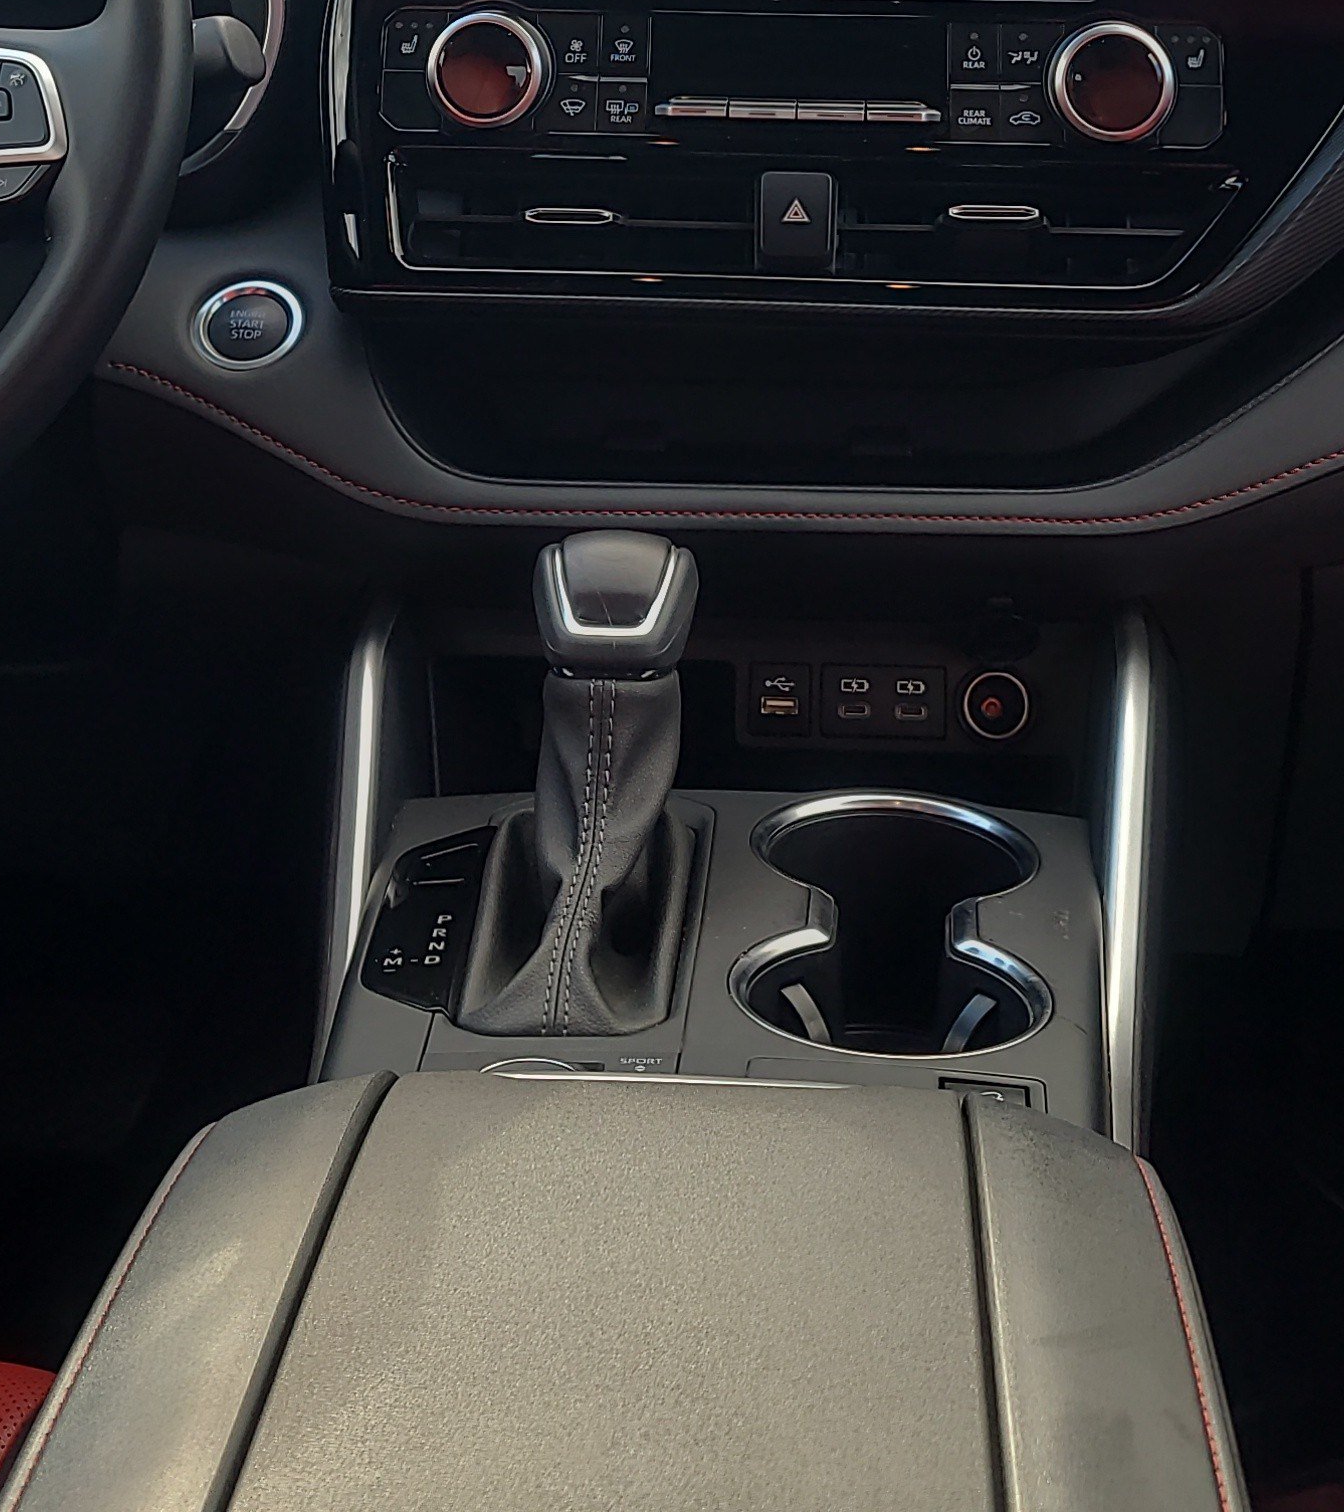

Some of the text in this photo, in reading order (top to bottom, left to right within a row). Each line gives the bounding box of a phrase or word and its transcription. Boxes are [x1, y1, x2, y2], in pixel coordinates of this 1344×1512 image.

[565, 53, 587, 63] OFF
[610, 54, 636, 62] FRONT
[963, 61, 986, 69] REAR
[610, 114, 632, 123] REAR
[957, 117, 992, 126] CLIMATE
[229, 319, 264, 329] START
[231, 329, 262, 339] STOP
[437, 914, 452, 924] P
[431, 928, 447, 938] R
[428, 941, 445, 951] N
[383, 955, 441, 966] M D
[619, 1057, 663, 1065] SPORT
